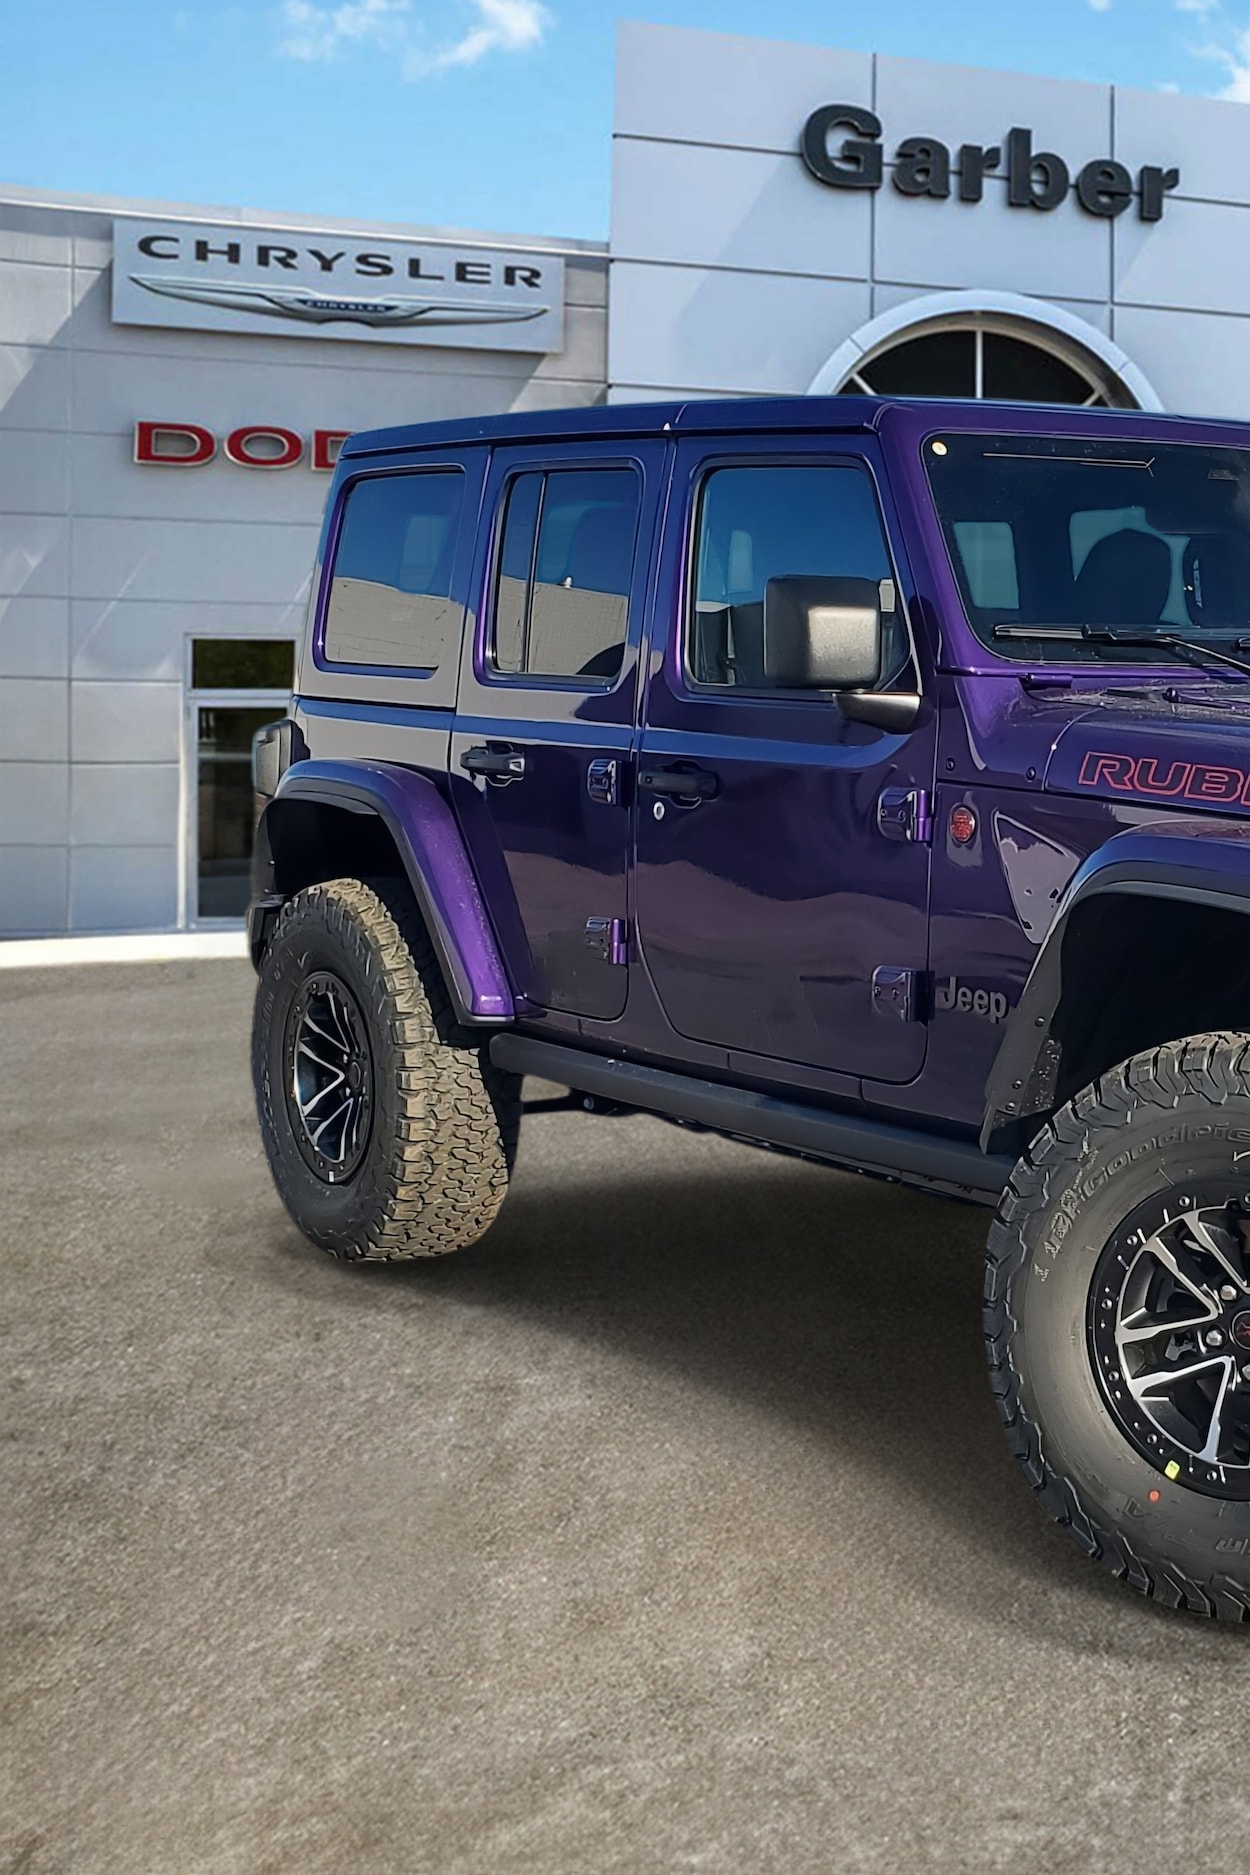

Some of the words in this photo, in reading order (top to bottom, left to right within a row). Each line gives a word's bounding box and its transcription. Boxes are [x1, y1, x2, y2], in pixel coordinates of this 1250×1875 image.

[800, 104, 1179, 222] Garber
[137, 235, 542, 288] CHRYSLER
[935, 976, 1008, 1025] Jeep
